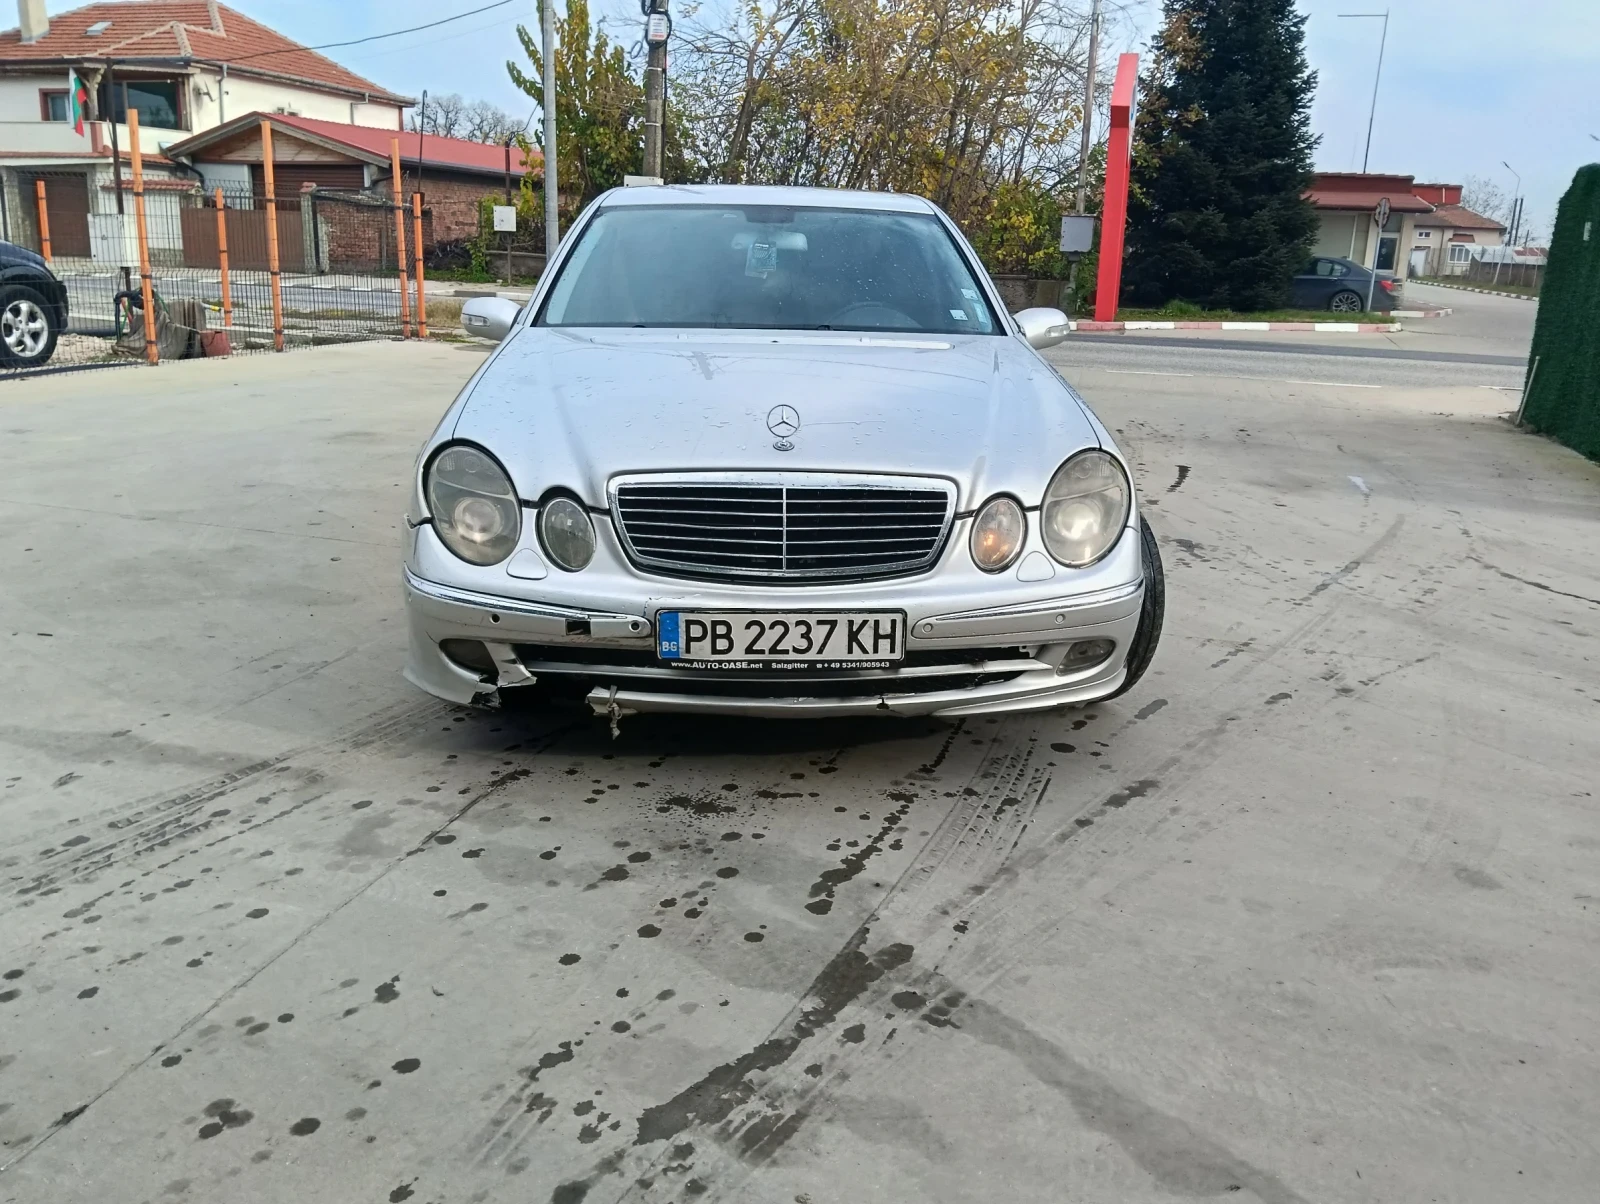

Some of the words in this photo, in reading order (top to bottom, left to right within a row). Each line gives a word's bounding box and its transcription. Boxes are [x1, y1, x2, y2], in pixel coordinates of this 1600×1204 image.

[684, 619, 735, 655] PB
[744, 619, 839, 655] 2237
[847, 619, 897, 655] KH
[662, 641, 678, 652] BG
[771, 662, 809, 670] Salzgitter
